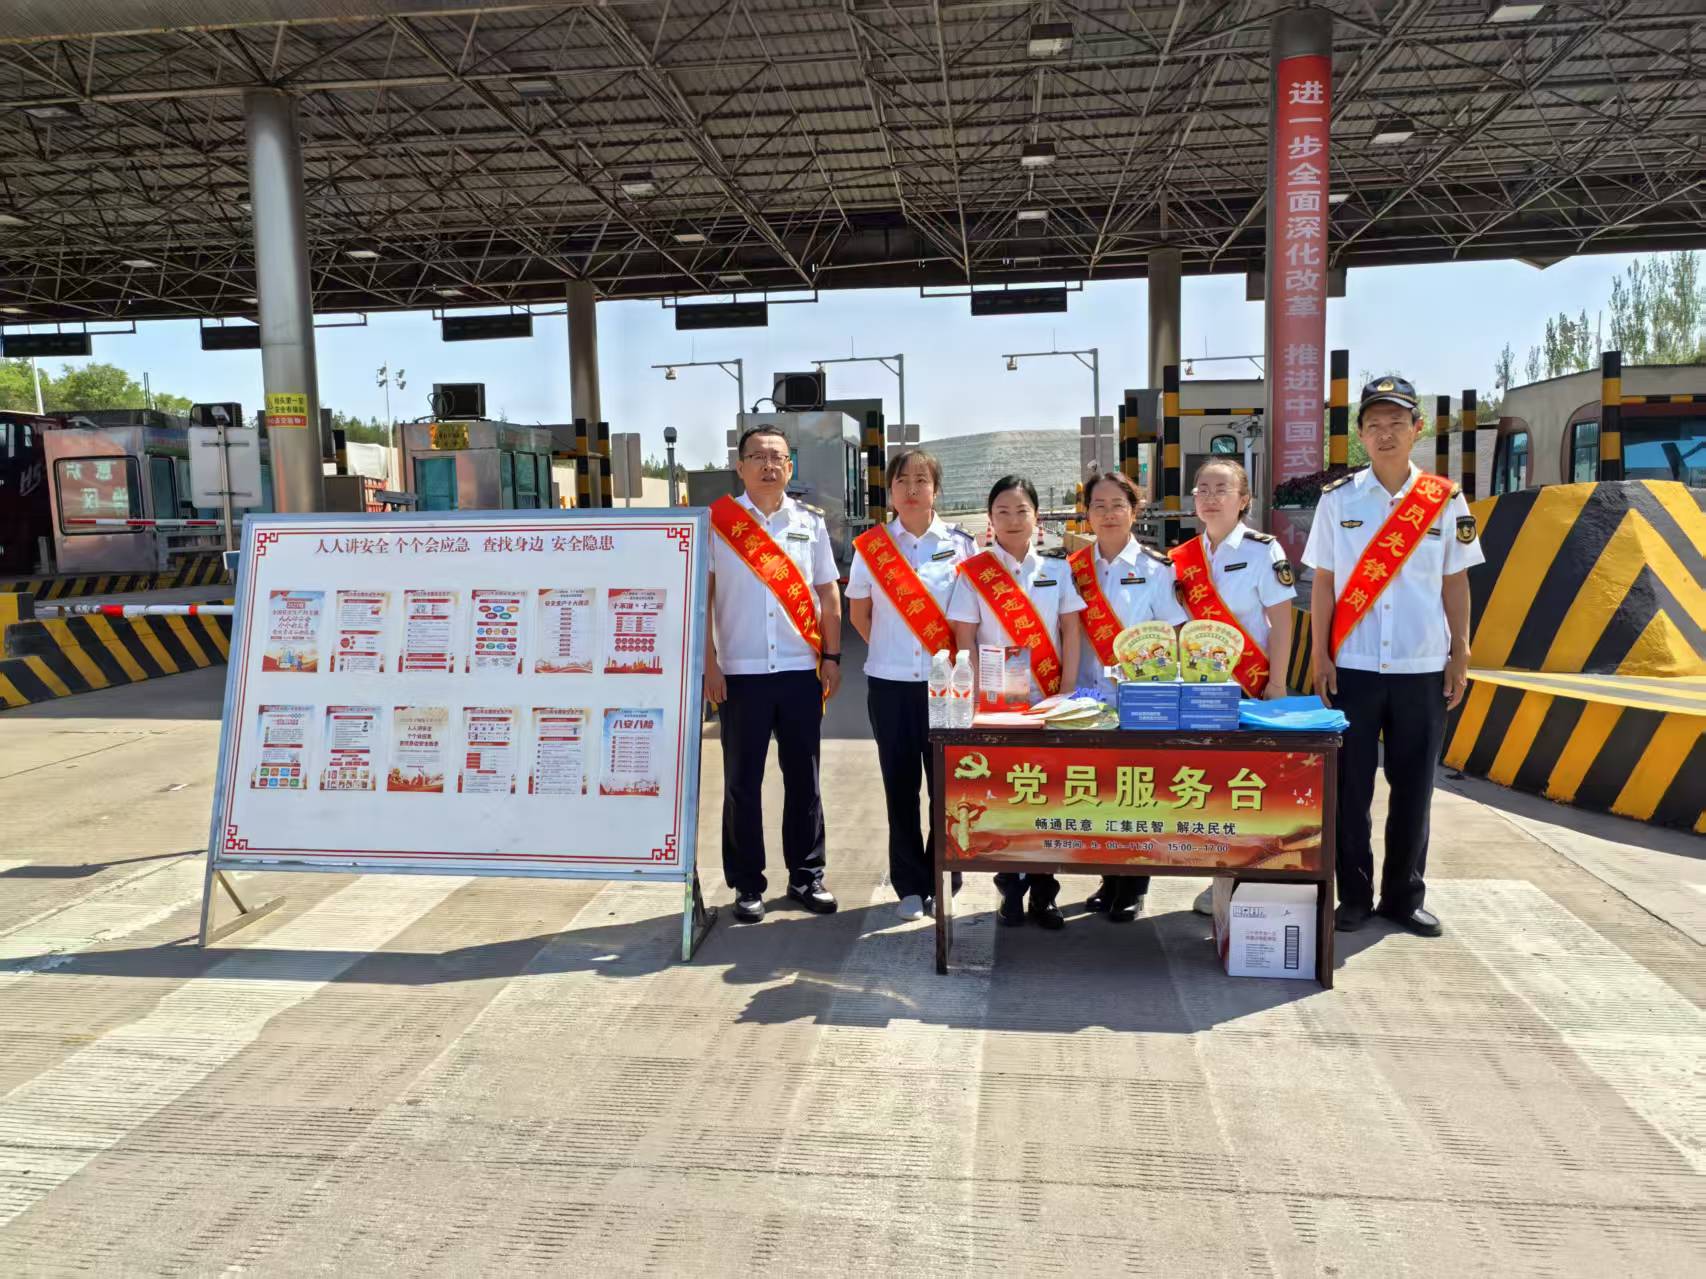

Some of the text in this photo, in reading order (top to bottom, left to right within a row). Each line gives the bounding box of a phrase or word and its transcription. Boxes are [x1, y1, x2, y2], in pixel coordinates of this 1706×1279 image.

[1285, 80, 1323, 316] 进一步全面深化改革
[316, 535, 615, 554] 人人讲安全 个个会应急 查找身边 安全隐患
[1344, 479, 1442, 613] 党员先锋岗
[1006, 763, 1267, 811] 党员服务台
[1035, 818, 1236, 835] 畅通民意 汇集民智 解决民忧
